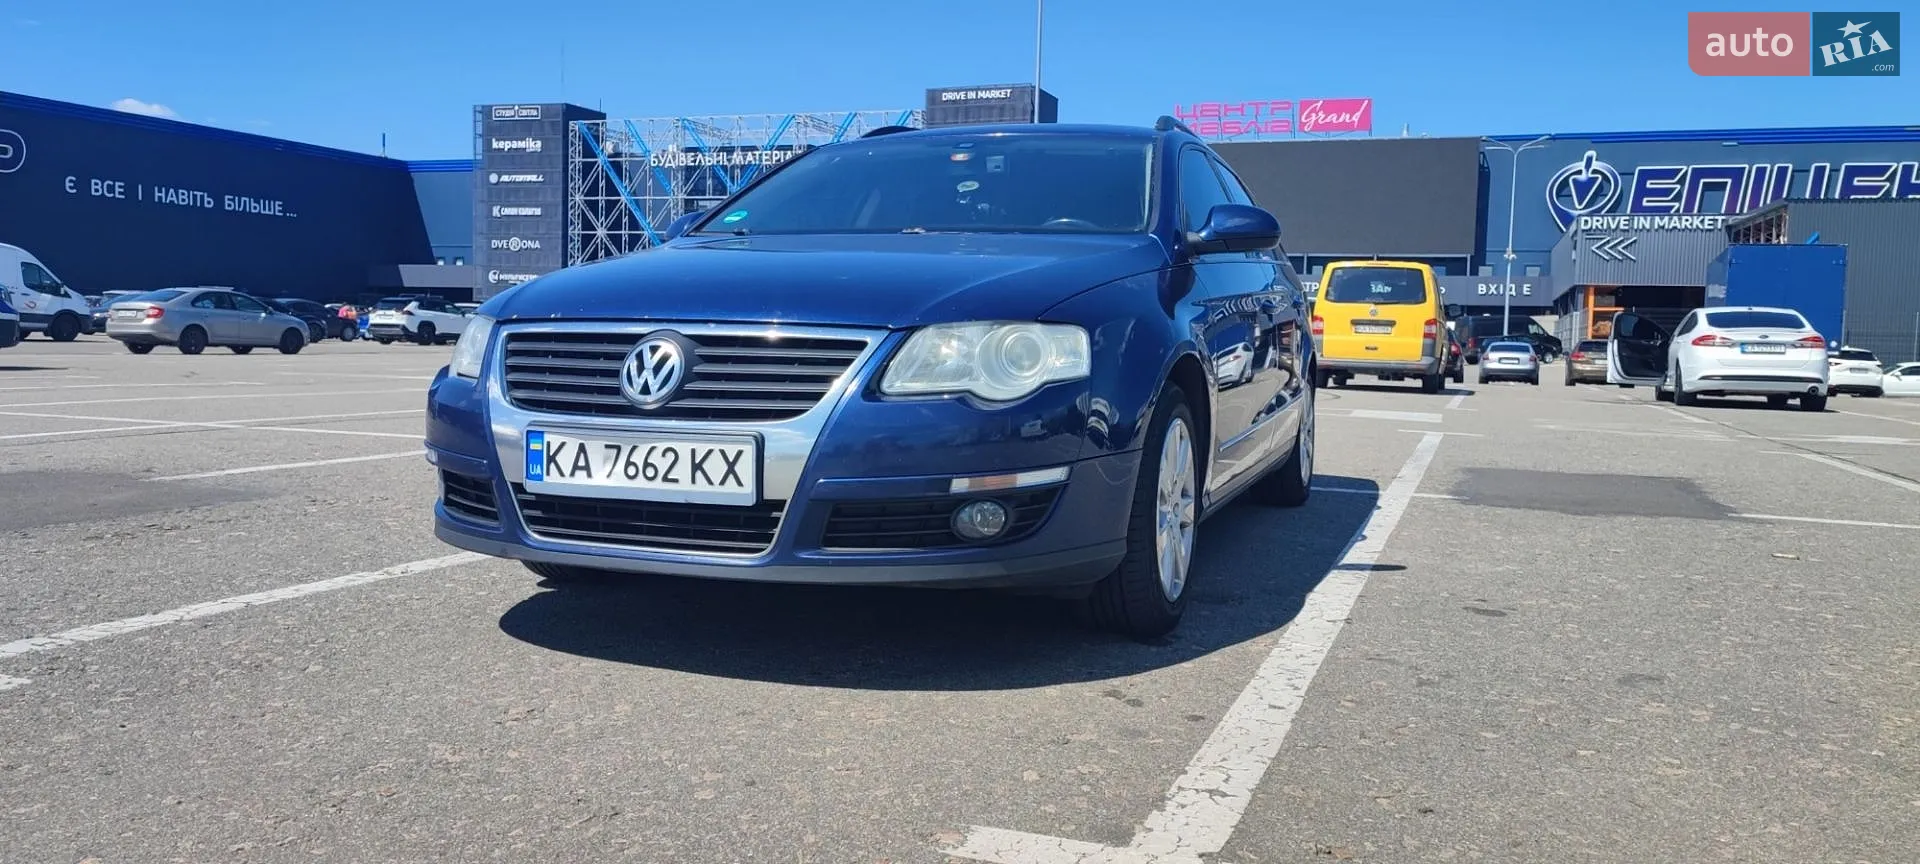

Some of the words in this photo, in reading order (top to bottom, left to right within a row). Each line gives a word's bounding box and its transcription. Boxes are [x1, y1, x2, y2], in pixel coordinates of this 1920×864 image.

[942, 92, 967, 101] DRIVE
[967, 91, 976, 99] IN
[977, 89, 1012, 99] MARKET
[1174, 101, 1293, 120] ЦЕНТР
[1301, 99, 1368, 132] Grand
[65, 176, 77, 194] Є
[90, 179, 126, 199] ВСЕ
[138, 184, 143, 201] І
[154, 186, 215, 209] НАВІТЬ
[1580, 215, 1629, 231] DRIVE
[1633, 216, 1649, 230] IN
[1654, 215, 1727, 230] MARKET
[529, 463, 542, 475] UA
[602, 443, 680, 484] 7662
